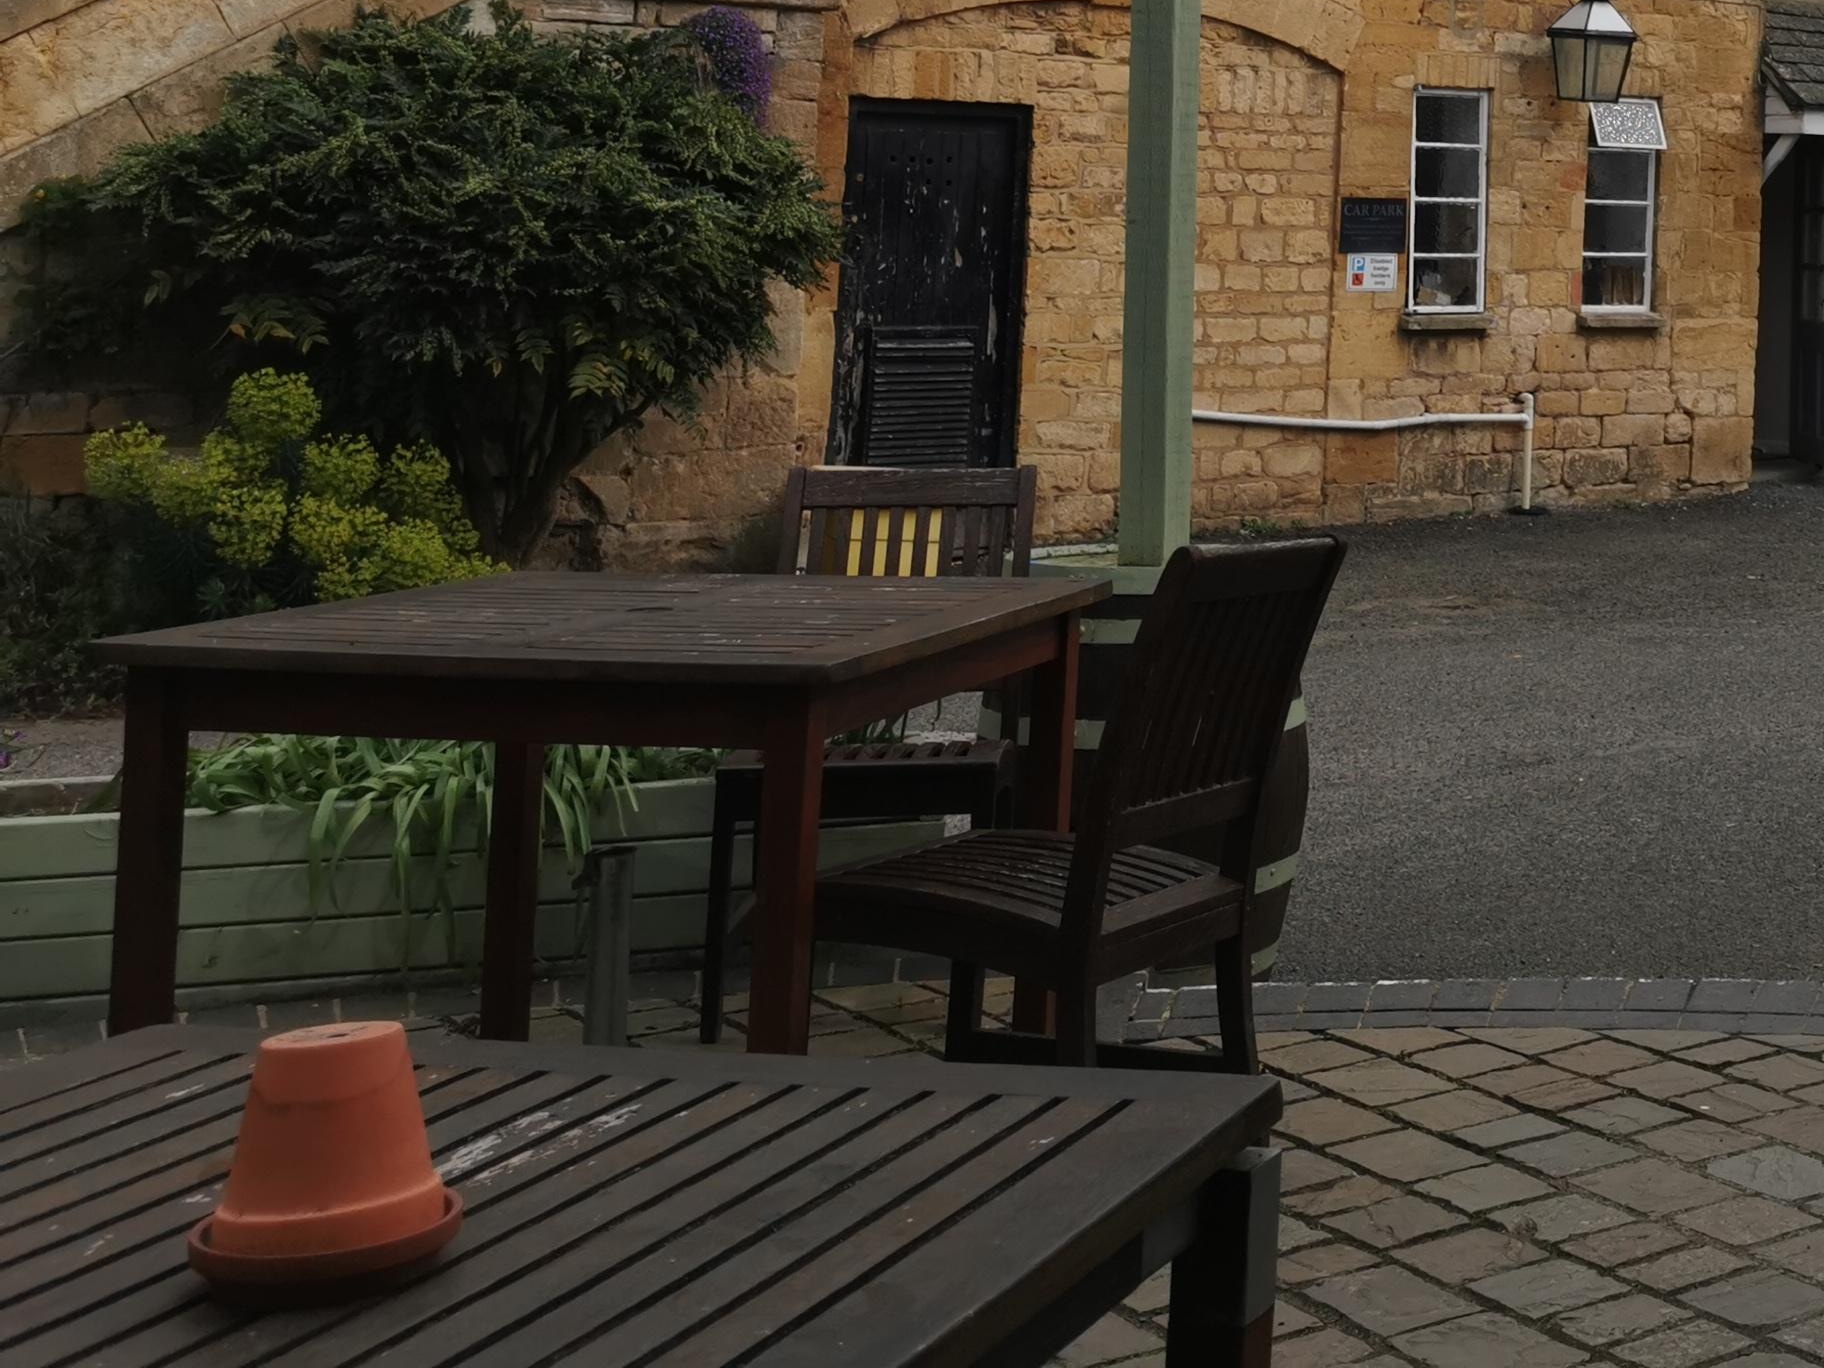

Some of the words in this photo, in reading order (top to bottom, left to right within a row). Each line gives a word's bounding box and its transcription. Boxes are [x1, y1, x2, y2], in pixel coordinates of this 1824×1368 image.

[1344, 204, 1370, 217] CAR
[1373, 204, 1405, 217] PARK
[1354, 257, 1364, 271] P
